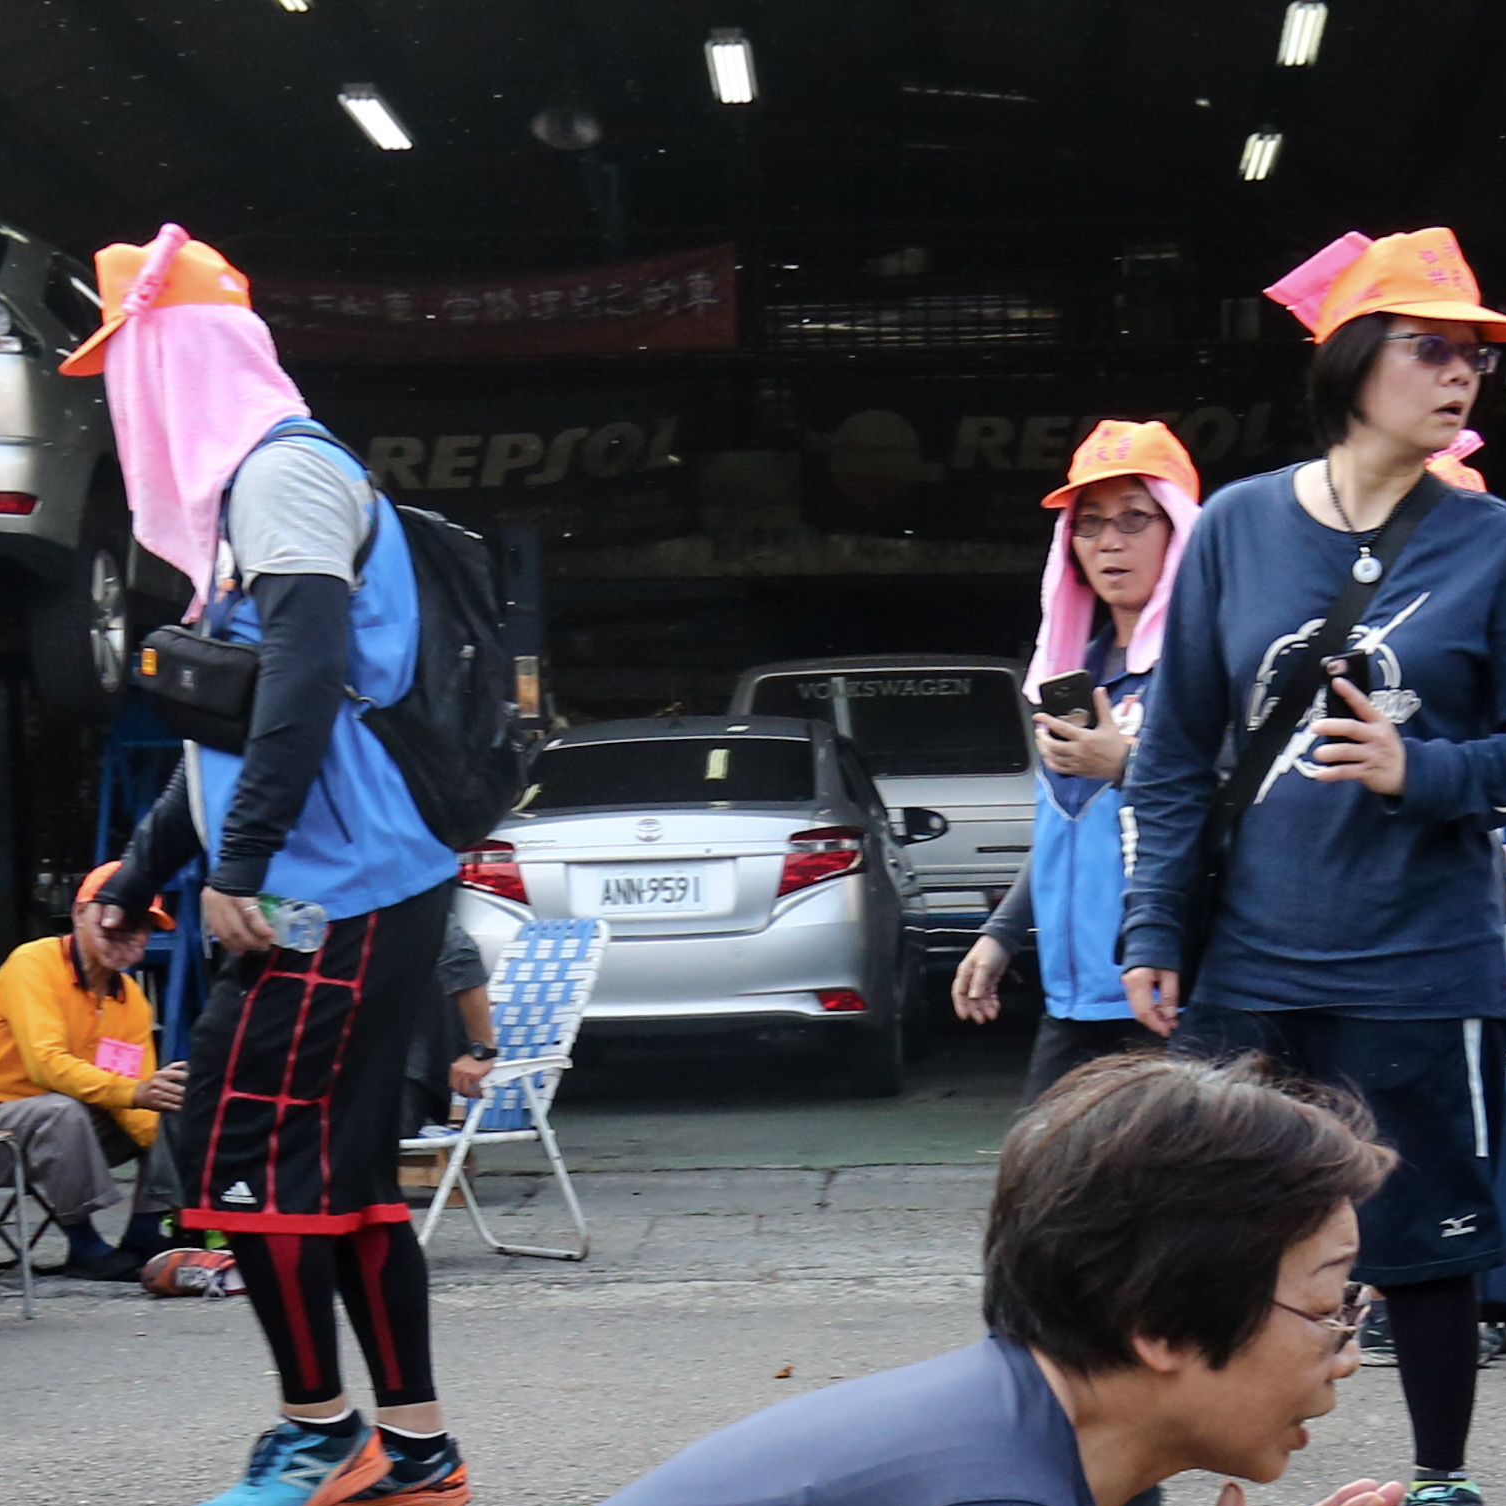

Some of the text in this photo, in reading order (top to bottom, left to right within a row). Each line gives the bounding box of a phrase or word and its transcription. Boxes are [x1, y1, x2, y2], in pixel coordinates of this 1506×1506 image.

[367, 414, 682, 490] REPSOL
[951, 401, 1275, 470] REOL
[601, 876, 701, 906] ANN-9591
